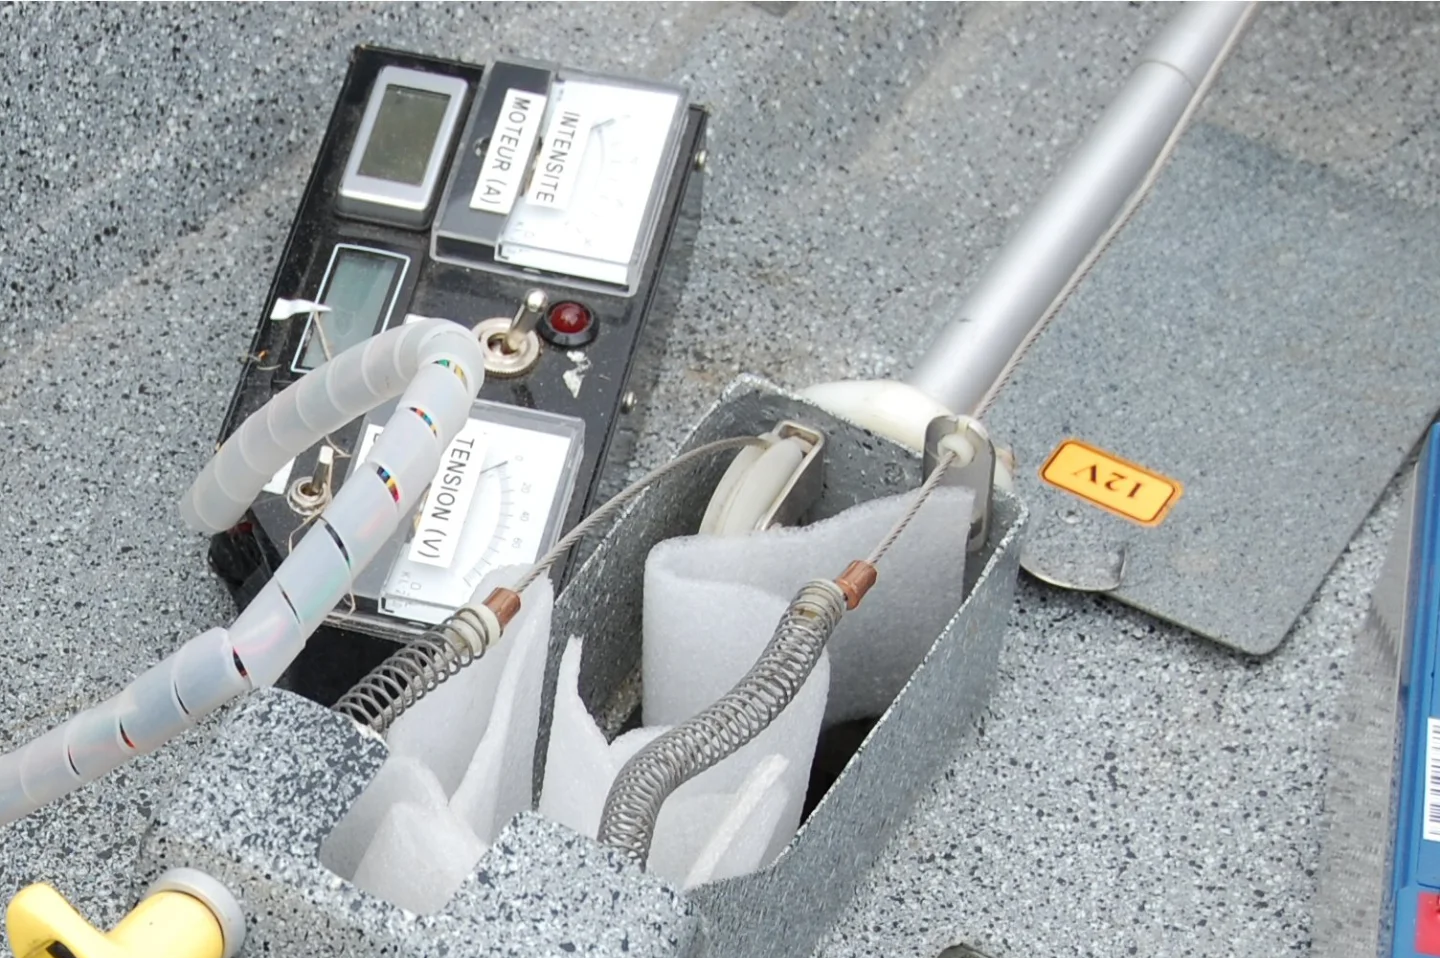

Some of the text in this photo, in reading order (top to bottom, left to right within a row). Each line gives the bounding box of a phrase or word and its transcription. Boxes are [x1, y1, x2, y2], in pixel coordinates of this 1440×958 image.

[479, 96, 531, 205] MOTEUR (A)
[536, 111, 580, 203] INTENSITE
[417, 439, 475, 558] TENSION (V)
[1070, 464, 1143, 499] 12V
